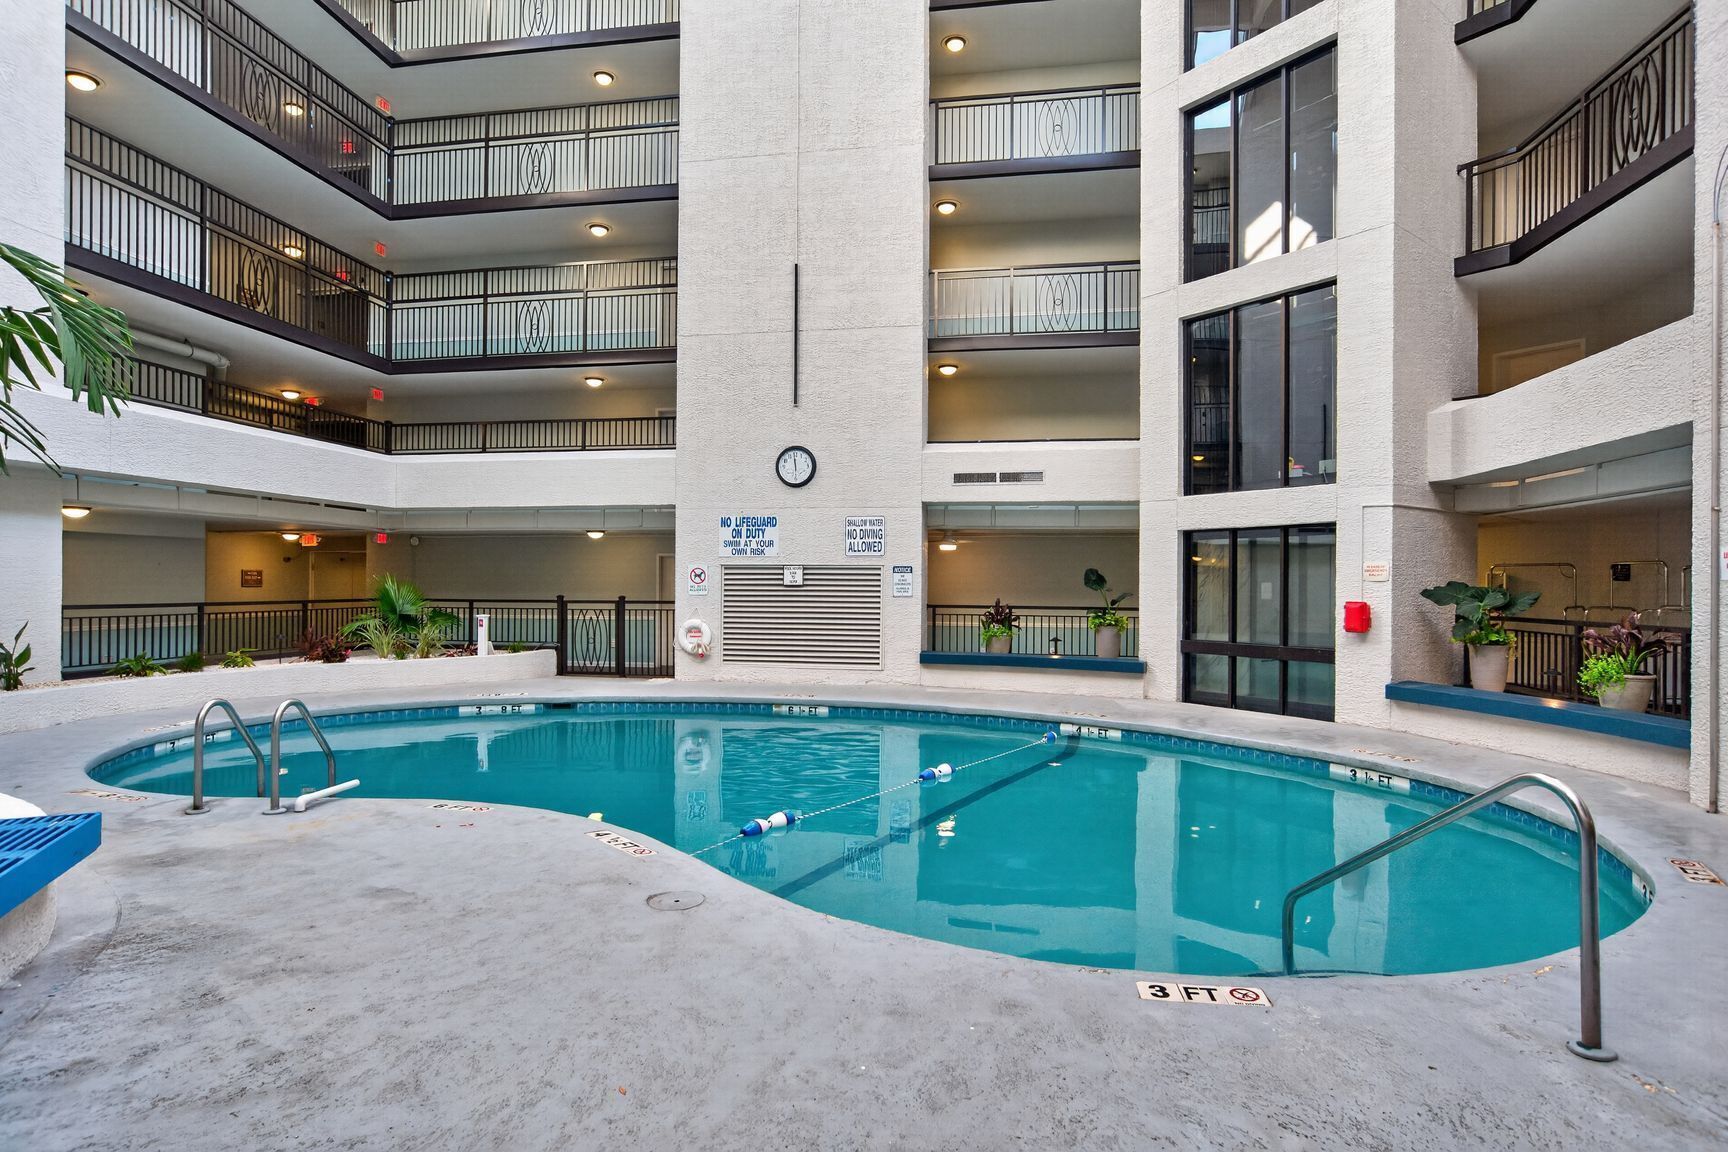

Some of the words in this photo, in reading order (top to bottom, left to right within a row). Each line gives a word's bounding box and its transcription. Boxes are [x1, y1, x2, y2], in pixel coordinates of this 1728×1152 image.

[720, 516, 732, 528] NO
[735, 516, 778, 528] LIFEGUARD
[847, 519, 868, 527] SHALLOW
[869, 519, 884, 527] WATER
[732, 528, 743, 539] ON
[746, 528, 766, 539] DUTY
[847, 529, 858, 540] NO
[859, 528, 883, 540] DIVING
[723, 540, 741, 548] SWIM
[743, 540, 753, 548] AT
[755, 540, 775, 548] YOUR
[848, 541, 883, 553] ALLOWED
[731, 548, 748, 556] OWN
[750, 548, 766, 556] RISK
[1148, 984, 1171, 999] 3
[1182, 986, 1218, 1002] FT
